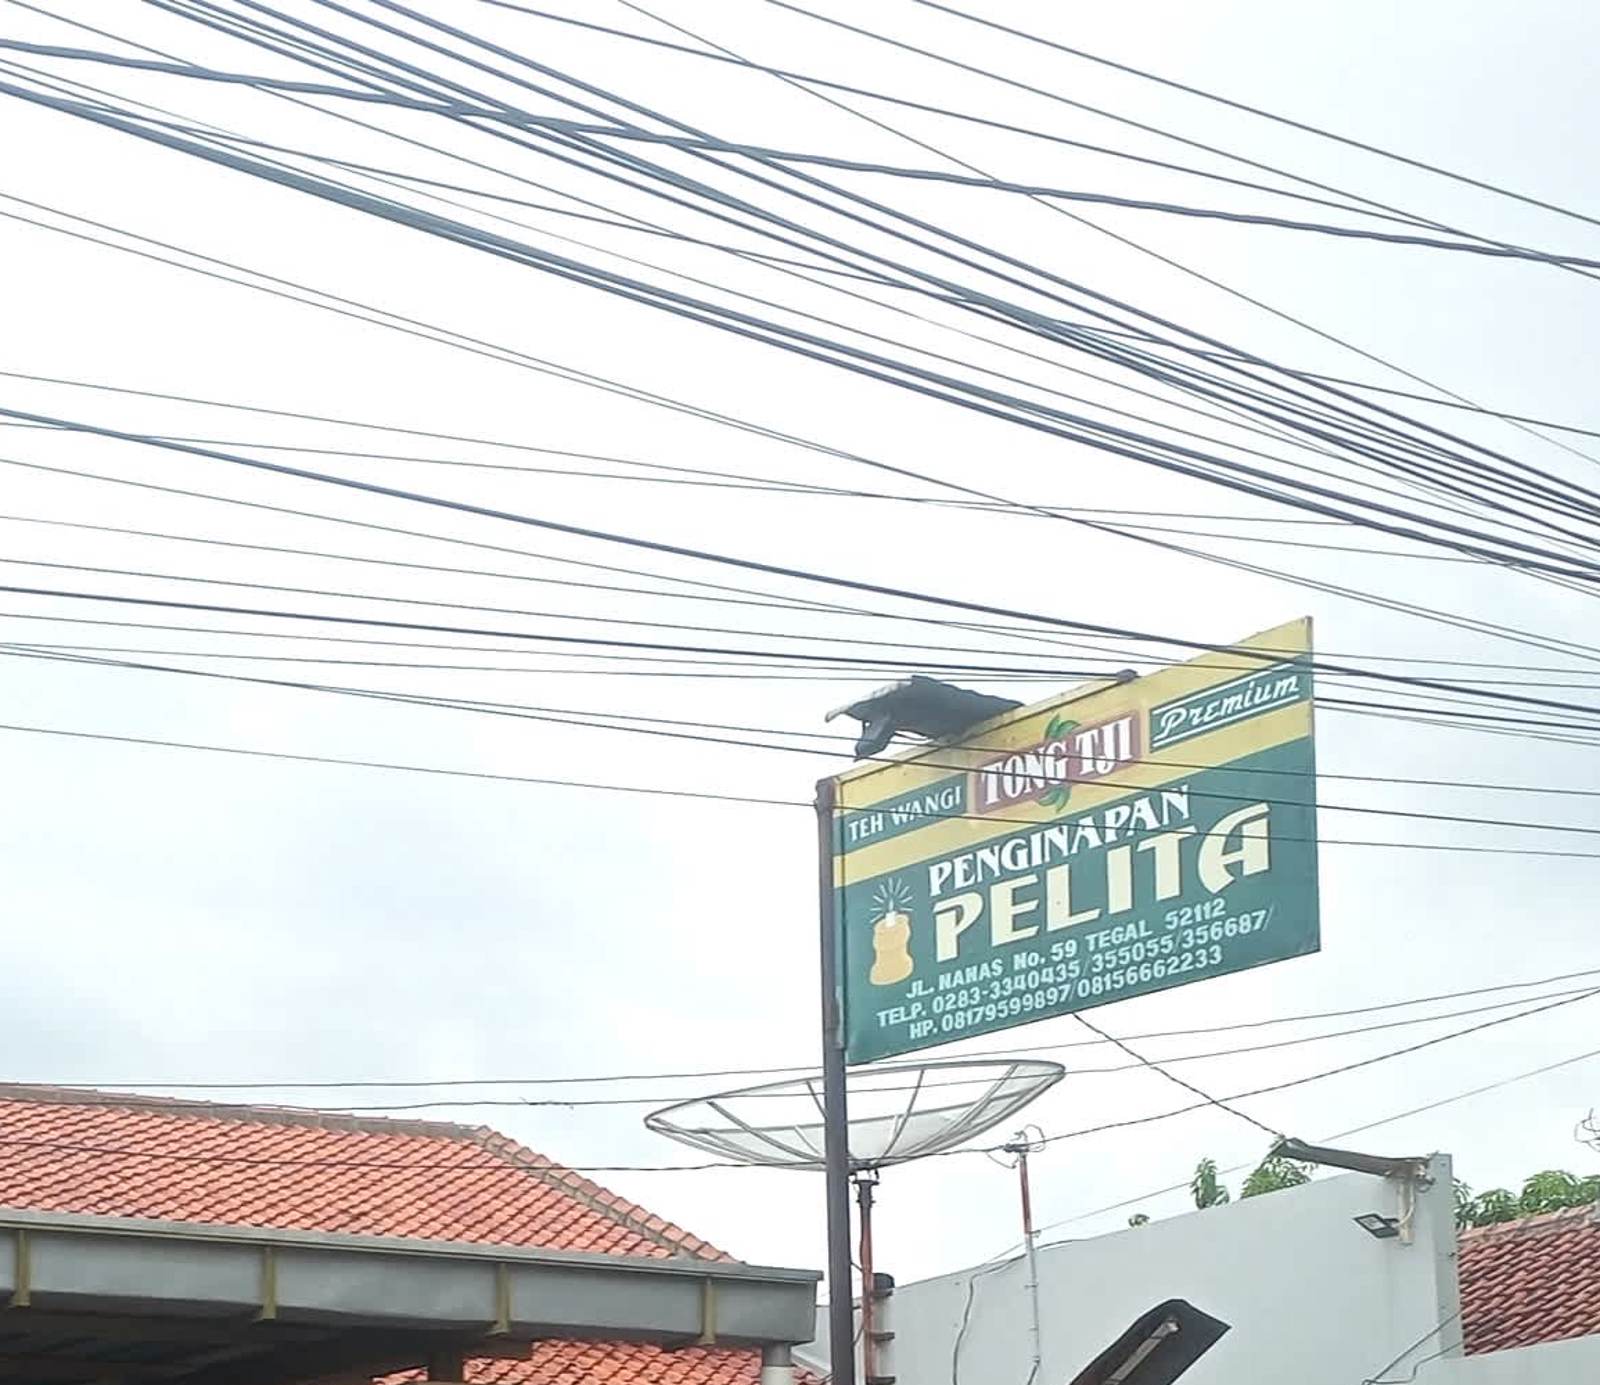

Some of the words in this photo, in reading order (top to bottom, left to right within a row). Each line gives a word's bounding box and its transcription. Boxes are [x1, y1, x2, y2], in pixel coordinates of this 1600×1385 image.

[1153, 675, 1299, 741] Premium
[981, 740, 1068, 805] TONG
[1075, 716, 1133, 775] TJI
[848, 813, 884, 842] TEH
[890, 785, 962, 824] WANGI
[928, 784, 1192, 896] PENGINAPAN
[933, 802, 1270, 963] PELITA
[906, 979, 934, 999] JL.
[939, 959, 1003, 991] NANAS
[1013, 952, 1046, 971] No.
[1051, 939, 1077, 962] 59
[1085, 920, 1152, 952] TEGAL
[1165, 897, 1226, 930] 52112
[876, 1001, 927, 1028] TELP.
[909, 1018, 938, 1040] HP.
